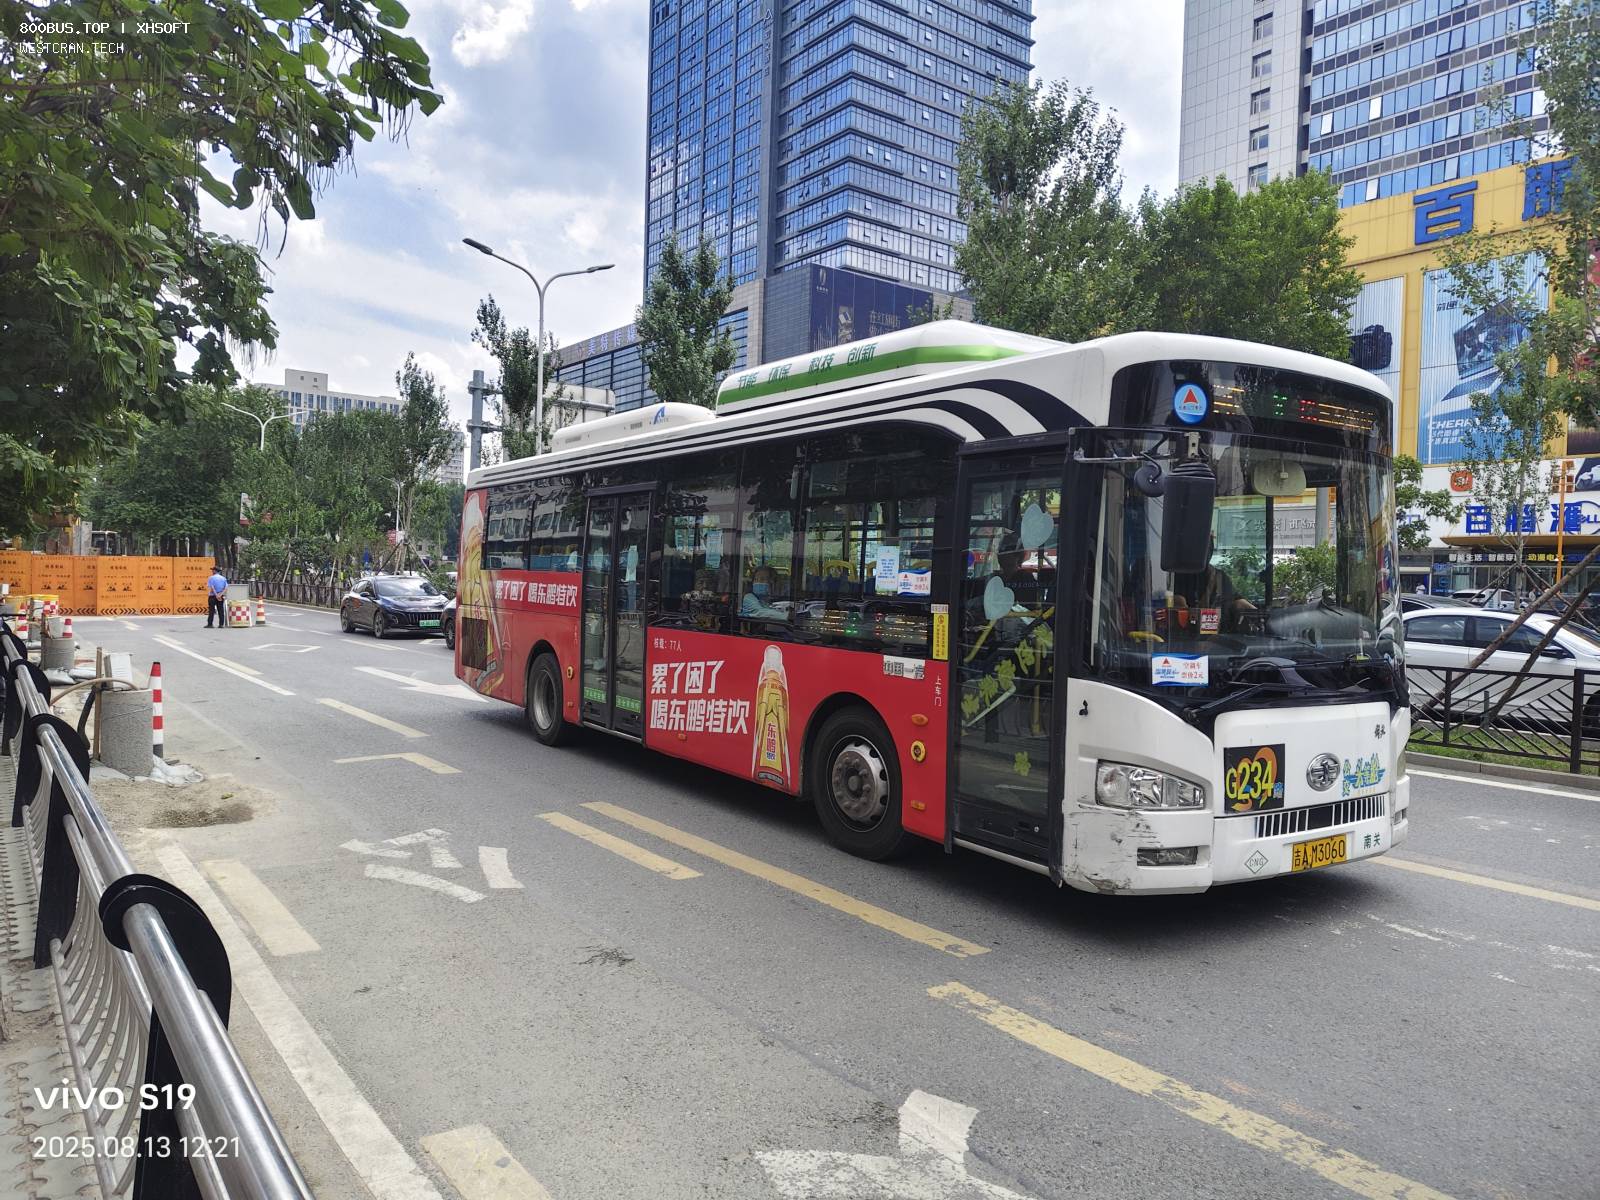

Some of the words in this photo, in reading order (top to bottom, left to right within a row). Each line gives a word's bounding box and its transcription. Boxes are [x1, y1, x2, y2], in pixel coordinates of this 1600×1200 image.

[808, 353, 834, 374] 科技
[847, 342, 878, 366] 创新
[495, 580, 527, 601] 累了困了
[528, 582, 578, 607] 喝东鹏特饮
[650, 660, 725, 694] 累了困了
[650, 698, 750, 735] 喝东鹏特饮
[1363, 832, 1381, 850] 南关
